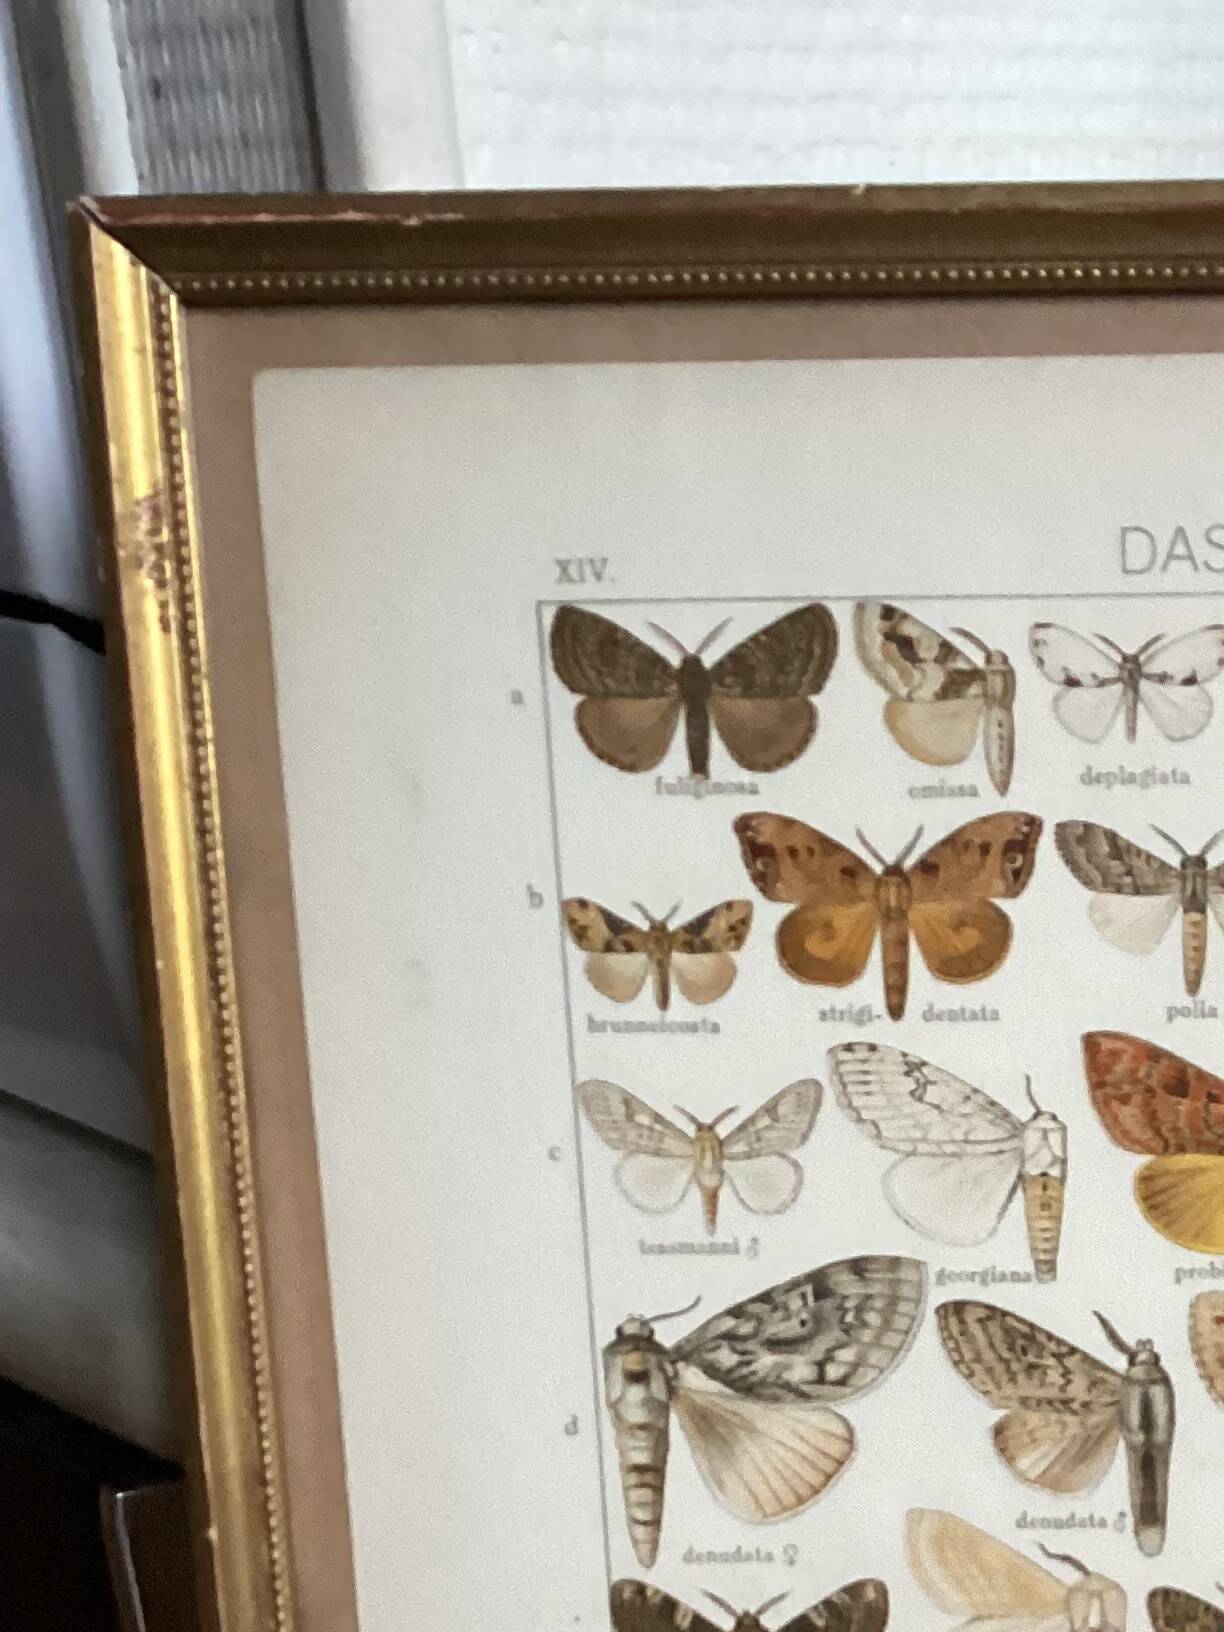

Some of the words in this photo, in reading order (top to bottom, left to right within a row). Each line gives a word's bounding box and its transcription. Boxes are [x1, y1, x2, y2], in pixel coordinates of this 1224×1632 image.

[1080, 766, 1190, 789] deplagiata
[526, 884, 543, 908] b
[922, 1001, 999, 1022] dentata
[1167, 1001, 1217, 1023] polia
[935, 1265, 1033, 1287] georgiana
[565, 1415, 578, 1436] d
[1016, 1512, 1107, 1529] denudata
[683, 1546, 774, 1563] denudata
